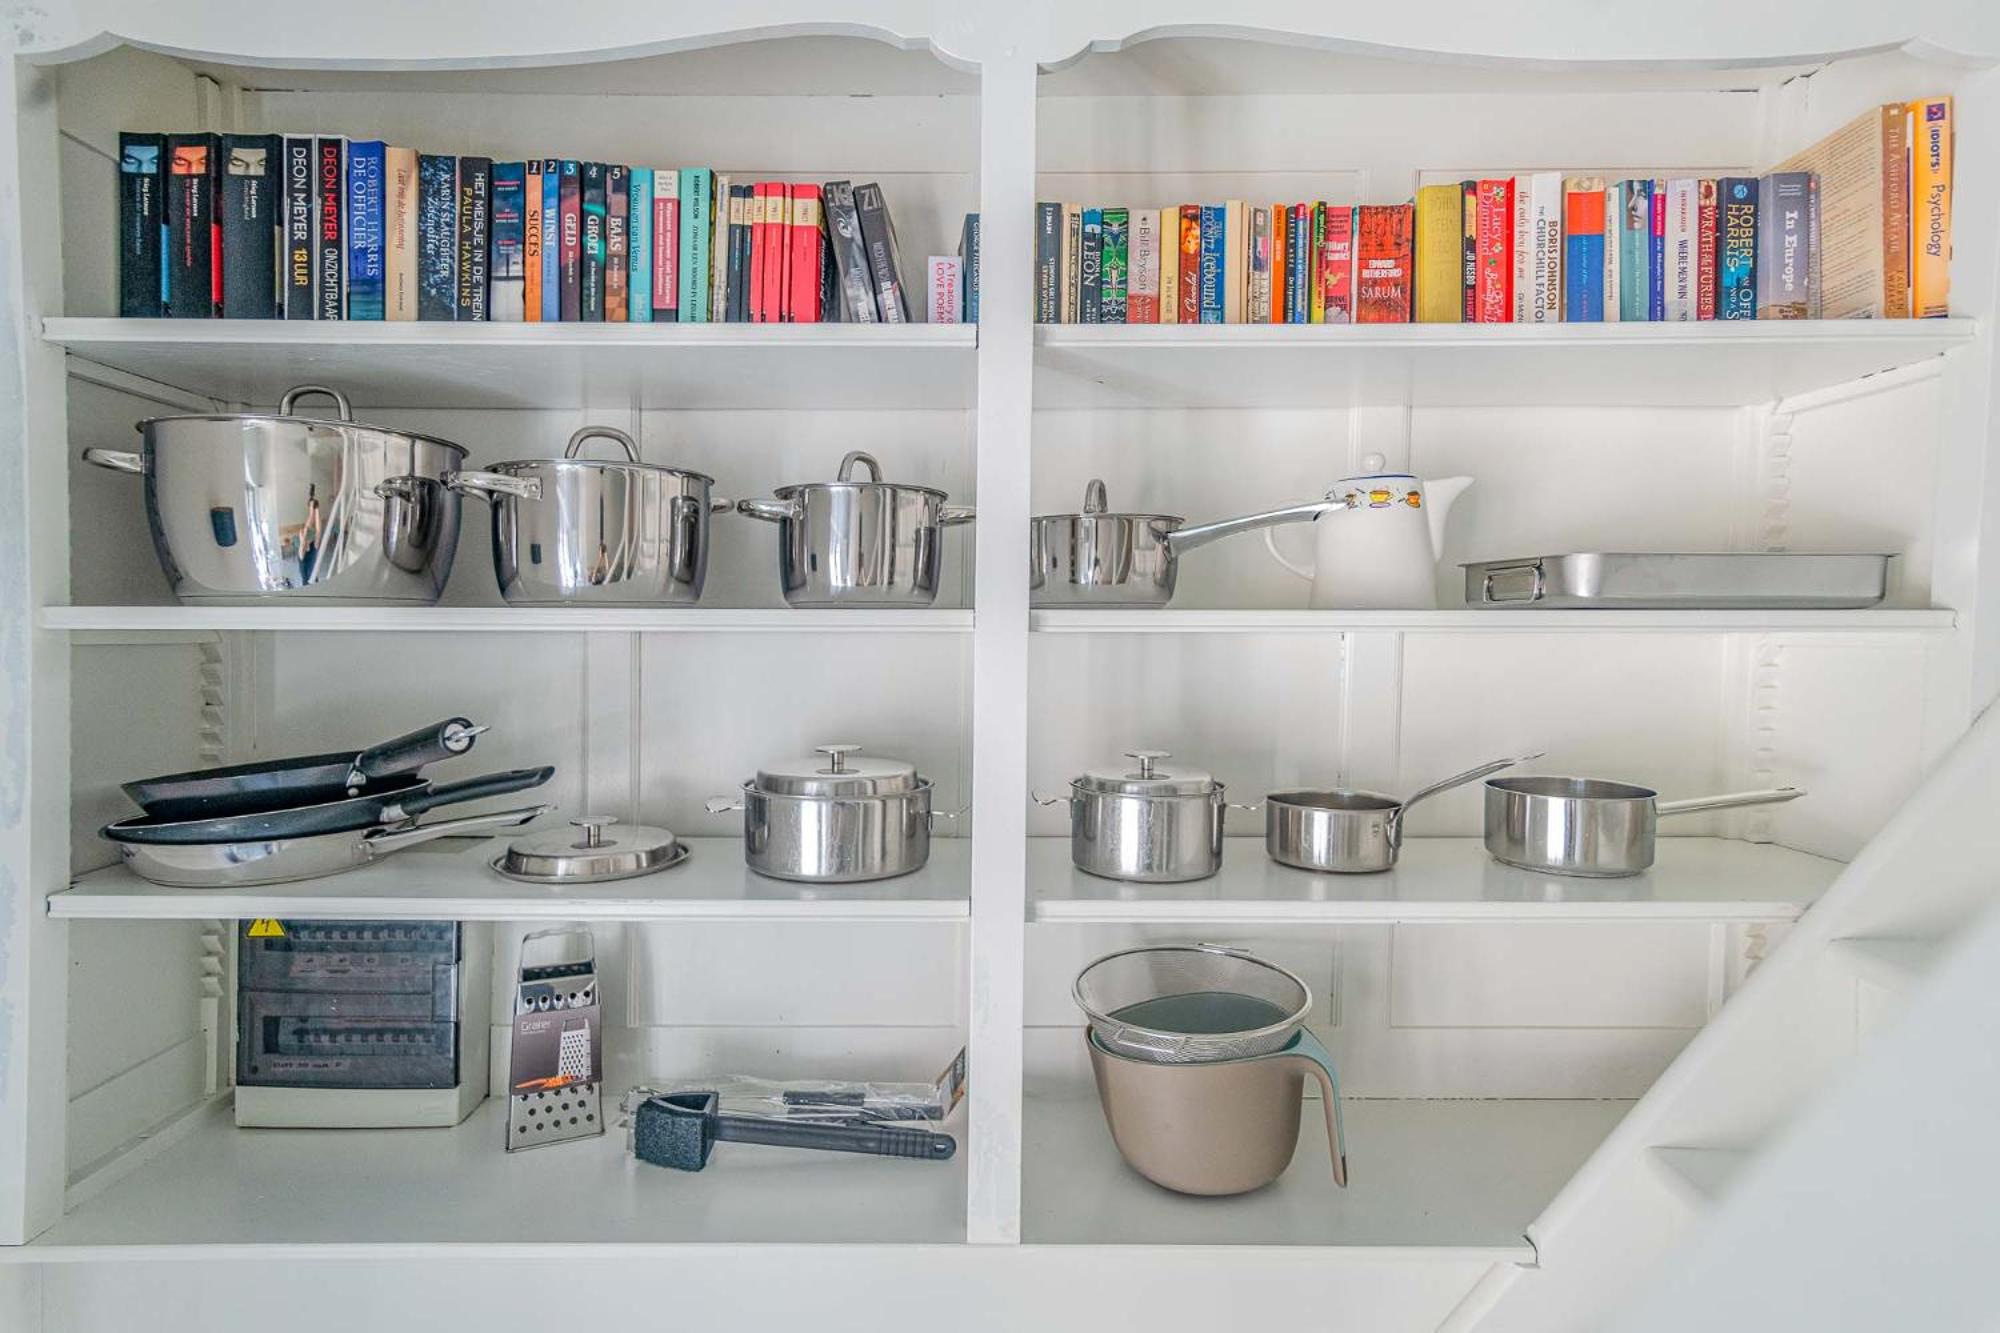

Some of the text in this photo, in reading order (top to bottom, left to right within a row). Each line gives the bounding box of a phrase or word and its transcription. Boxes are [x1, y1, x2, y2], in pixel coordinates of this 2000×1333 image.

[323, 147, 337, 188] DEON
[530, 162, 538, 173] 1
[546, 161, 554, 172] 2
[566, 163, 574, 175] 3
[1929, 129, 1940, 169] IDIOT'S
[589, 166, 597, 178] 4
[612, 167, 621, 180] 5
[1889, 127, 1902, 254] THE ASHFORD AFFAIR
[293, 147, 308, 286] DEON MEYER 13 UUR
[324, 193, 337, 241] MEYER
[353, 157, 366, 249] DE OFFICIER
[367, 157, 379, 277] ROBERT HARRIS
[1482, 189, 1494, 256] Diamond
[1492, 206, 1505, 241] Lucy
[1926, 184, 1946, 257] Psychology
[440, 173, 450, 278] KARIN SLAUGHTER
[528, 210, 539, 257] SUCCES
[545, 208, 556, 247] WINST
[565, 213, 577, 246] GELD
[587, 215, 599, 254] GROEI
[610, 217, 622, 251] BAAS
[1139, 227, 1150, 244] Bill
[1203, 210, 1216, 249] KOONTZ
[1701, 206, 1713, 252] WRATH
[1727, 203, 1740, 268] HARRIS
[1739, 204, 1754, 268] ROBERT
[461, 188, 472, 307] PAULA HAWKINS
[472, 173, 485, 320] HET MEISJE IN DE TREIN
[631, 246, 641, 272] Venus
[947, 262, 955, 270] A
[1084, 241, 1096, 286] LEON
[1466, 250, 1475, 261] JO
[1535, 218, 1546, 281] CHURCHILL
[1547, 220, 1558, 310] BORIS JOHNSON
[1678, 240, 1688, 265] WHERE
[1782, 210, 1798, 292] In Europe
[936, 262, 944, 289] LOVE
[1137, 249, 1150, 290] Bryson
[1203, 253, 1221, 308] Icebound
[1678, 267, 1688, 283] MEN
[1701, 267, 1713, 310] FURIES
[945, 273, 956, 314] Treasury
[1184, 271, 1197, 312] Chocolat
[1362, 286, 1402, 298] SARUM
[1677, 284, 1687, 300] WIN
[1729, 287, 1737, 303] AND
